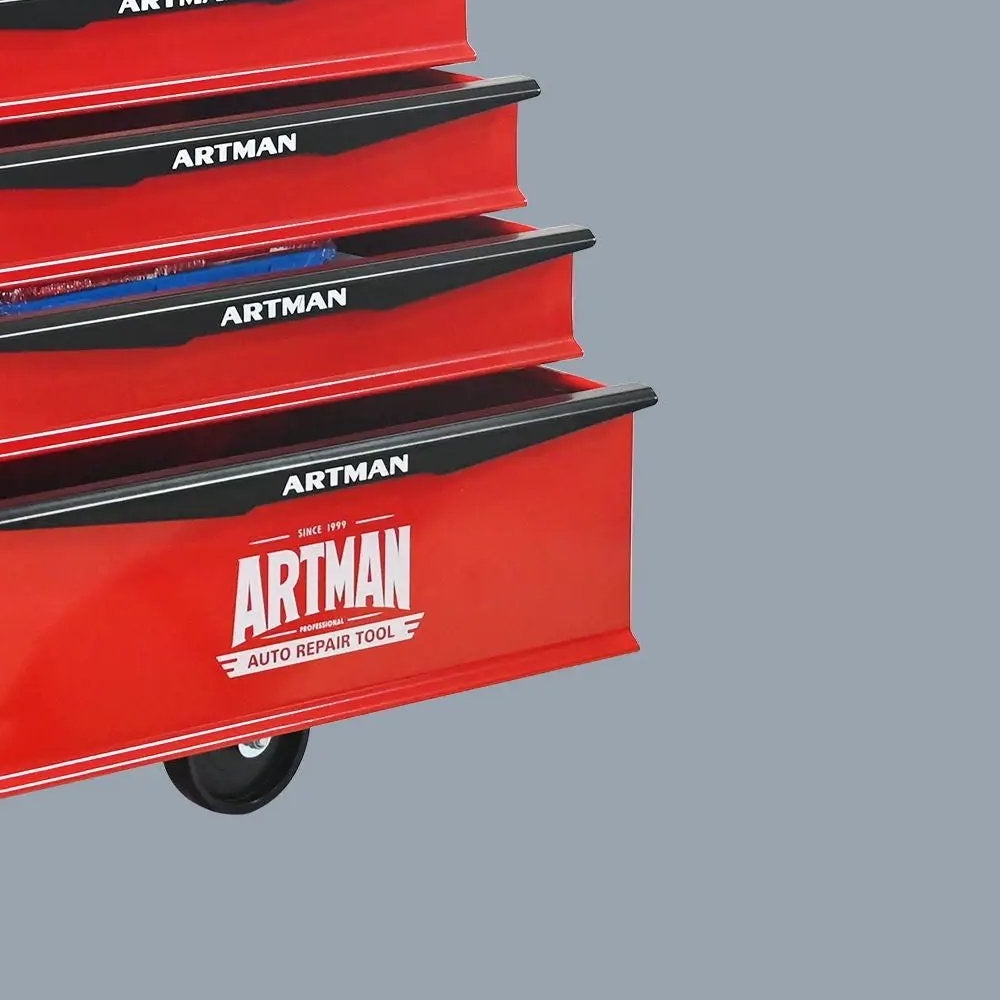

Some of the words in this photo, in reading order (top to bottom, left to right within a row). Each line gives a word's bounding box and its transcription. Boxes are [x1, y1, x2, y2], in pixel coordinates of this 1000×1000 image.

[172, 132, 297, 170] ARTMAN
[220, 287, 347, 327] ARTMAN
[282, 453, 409, 496] ARTMAN
[298, 525, 322, 538] SINCE
[327, 520, 347, 532] 1999
[232, 524, 411, 648] ARTMAN
[299, 618, 345, 633] PROFESSIONAL
[247, 647, 291, 669] AUTO
[296, 634, 350, 658] REPAIR
[355, 624, 396, 645] TOOL
